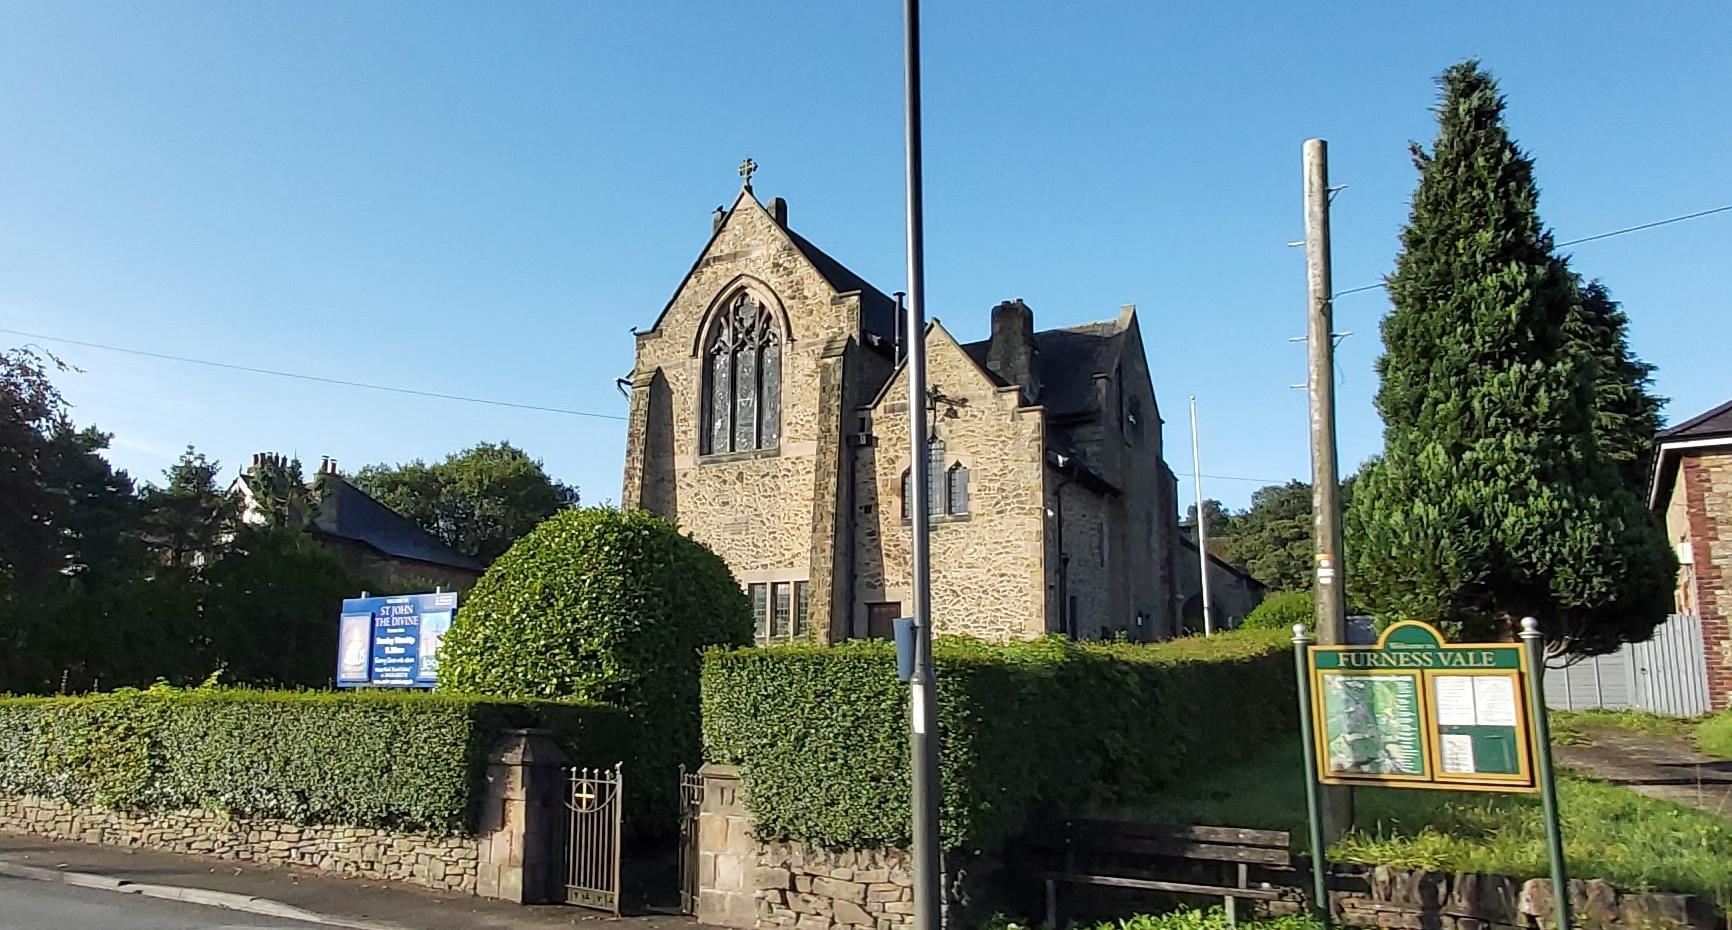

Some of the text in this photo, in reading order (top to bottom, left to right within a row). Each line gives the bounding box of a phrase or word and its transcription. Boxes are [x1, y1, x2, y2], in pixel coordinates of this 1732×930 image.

[381, 605, 414, 617] ST JOHN
[375, 615, 419, 627] THE DIVINE
[1338, 651, 1496, 667] FURNESS VALE
